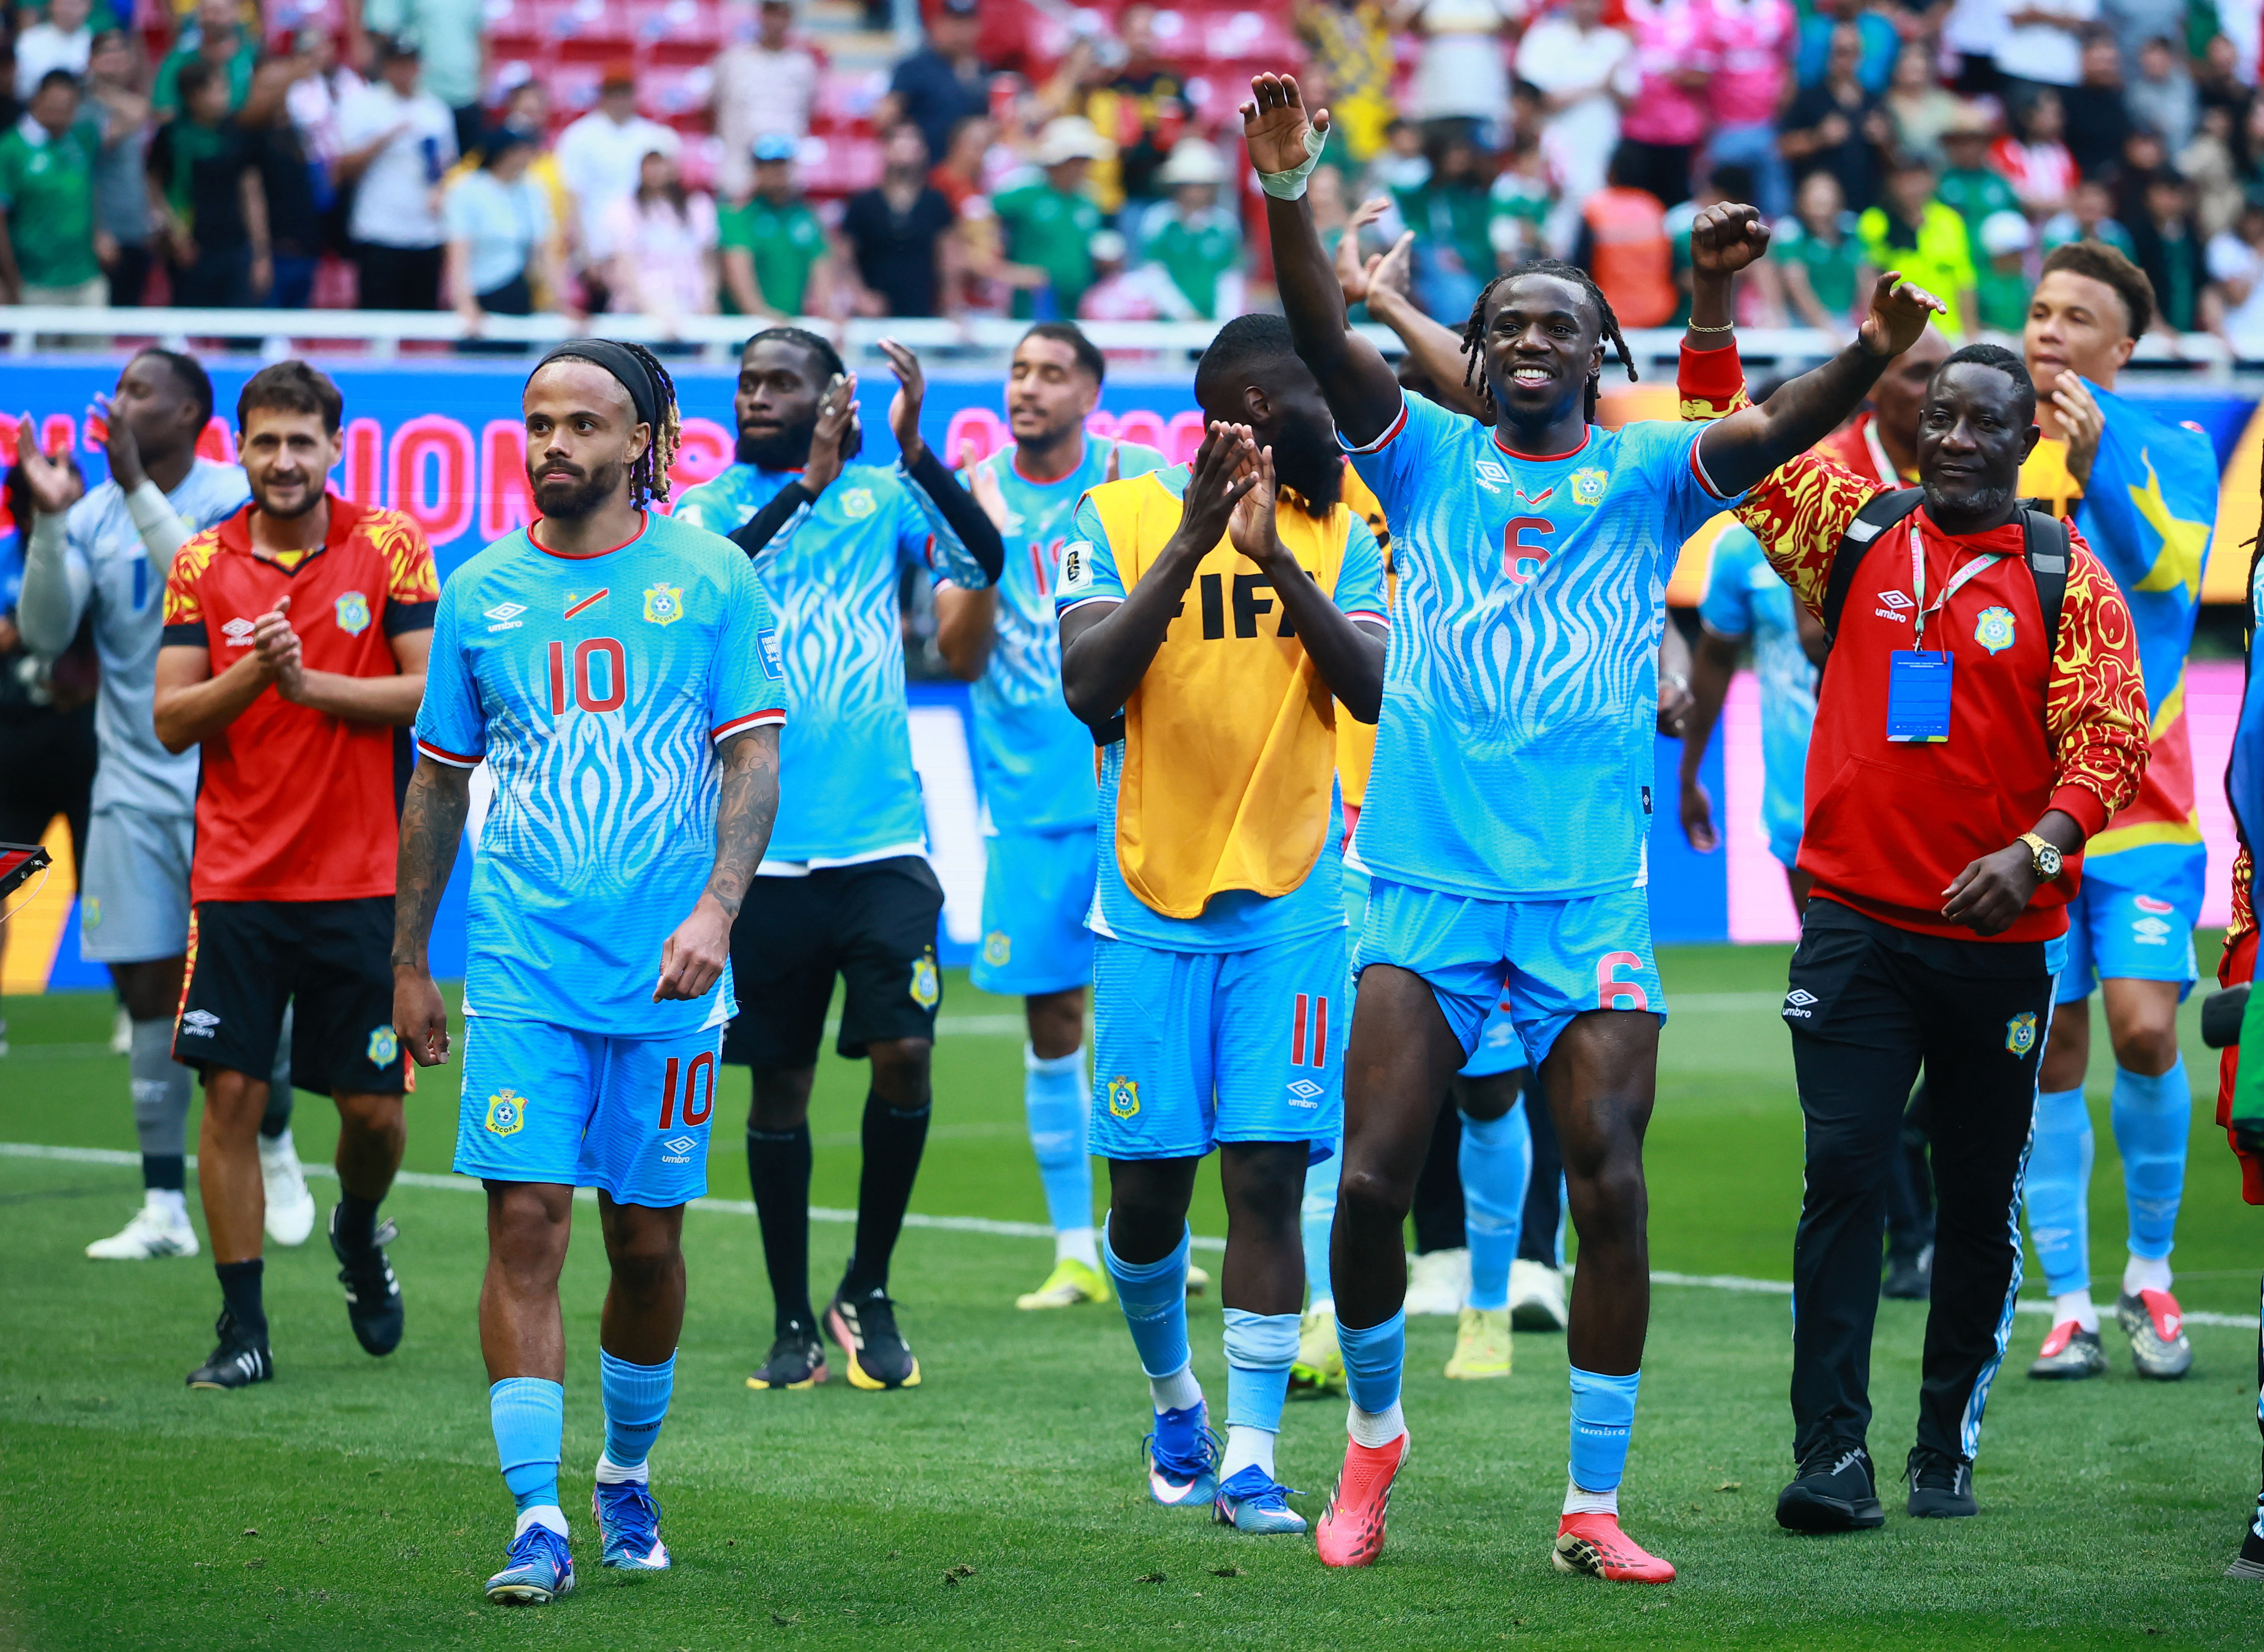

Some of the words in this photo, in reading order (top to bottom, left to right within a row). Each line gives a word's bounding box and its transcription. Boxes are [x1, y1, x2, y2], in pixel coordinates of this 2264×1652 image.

[1475, 477, 1501, 494] mbro
[1504, 516, 1555, 585] 6
[1161, 571, 1316, 643] IF
[651, 612, 678, 622] FECOFA
[1875, 608, 1907, 623] umbro
[488, 620, 522, 632] umbro
[548, 636, 627, 717] 10
[1596, 951, 1648, 1012] 6
[1782, 1007, 1812, 1018] umbro
[1291, 993, 1328, 1069] 11
[658, 1050, 714, 1130] 10
[1288, 1098, 1318, 1109] umbro
[491, 1123, 518, 1133] FECOFA
[662, 1155, 690, 1164] umbro
[1580, 1427, 1626, 1436] umbro
